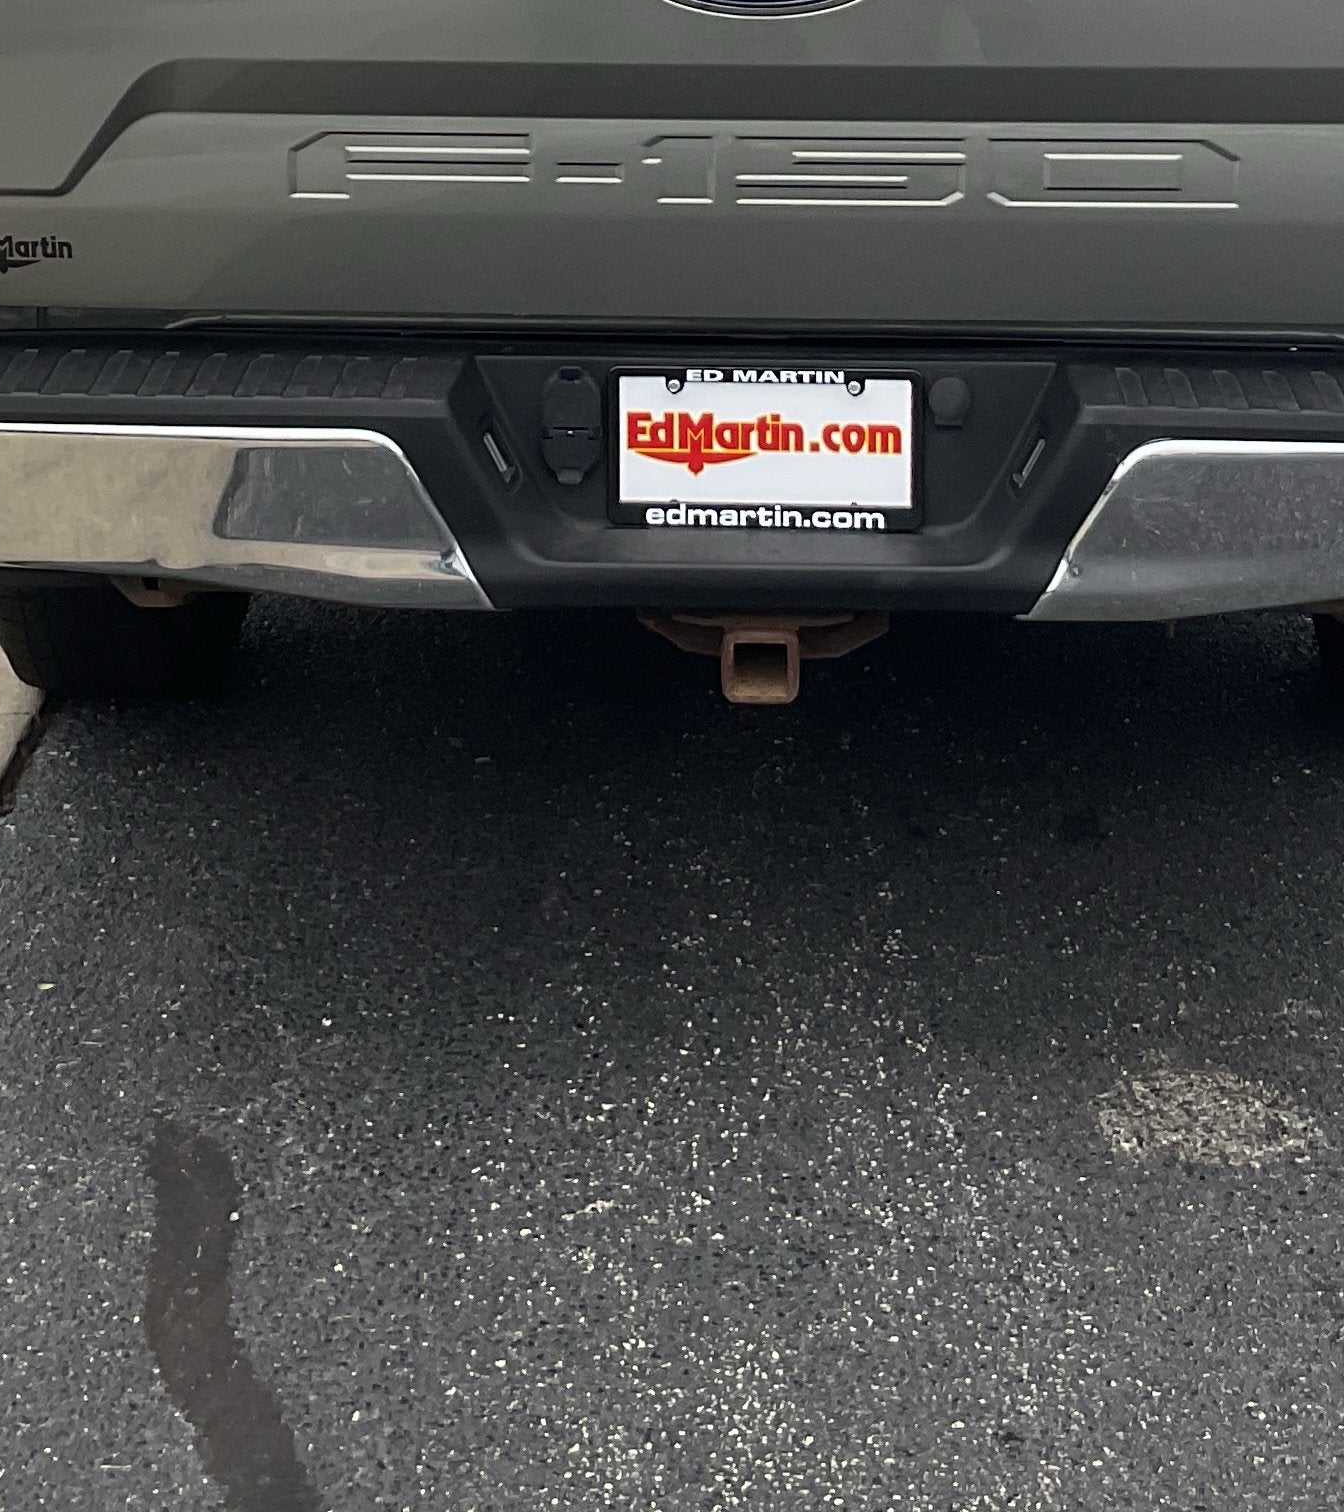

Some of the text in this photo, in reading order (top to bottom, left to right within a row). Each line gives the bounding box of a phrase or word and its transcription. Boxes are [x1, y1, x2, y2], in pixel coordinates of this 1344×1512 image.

[288, 131, 1242, 210] F-150
[685, 369, 846, 385] ED MARTIN
[626, 411, 903, 458] EdMartin.com
[644, 503, 886, 531] edmartin.com
